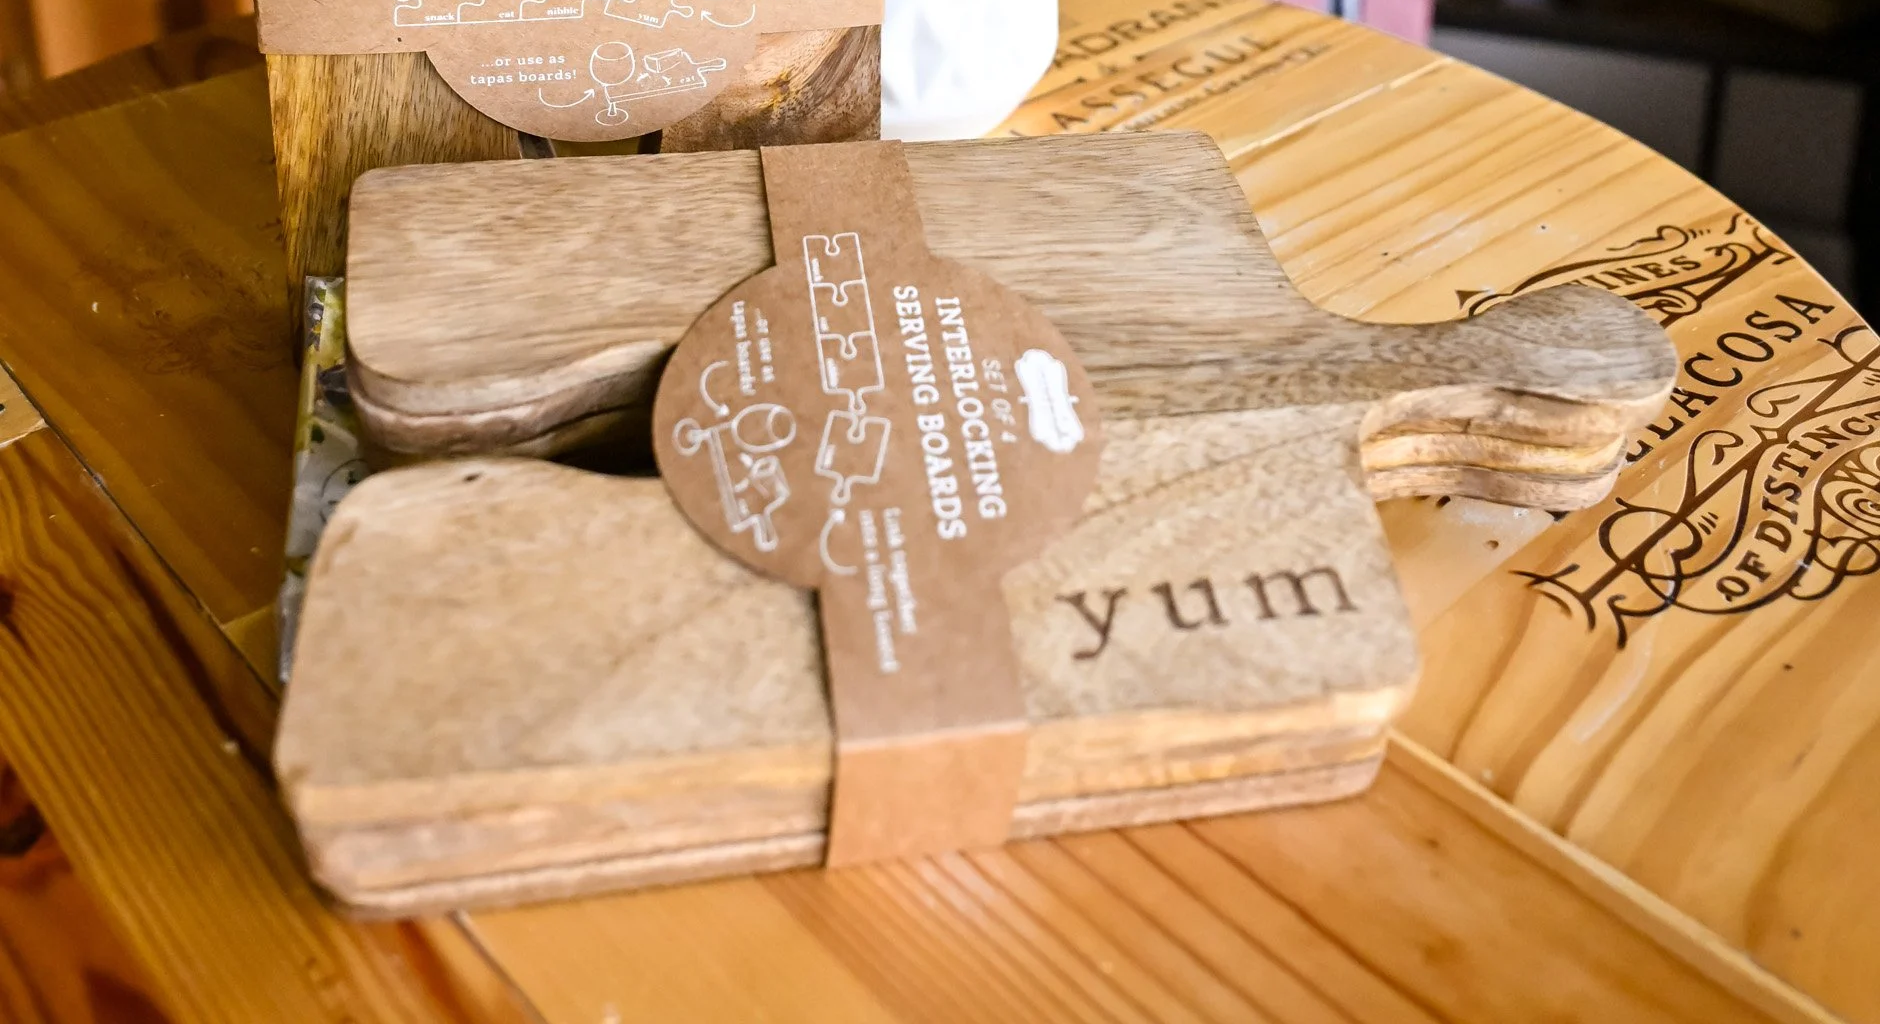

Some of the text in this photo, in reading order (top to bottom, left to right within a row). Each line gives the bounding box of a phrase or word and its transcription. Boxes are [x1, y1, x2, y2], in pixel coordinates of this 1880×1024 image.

[424, 12, 456, 22] snack
[470, 69, 577, 86] tapas boards!
[517, 56, 543, 66] use
[549, 55, 566, 65] as
[1566, 255, 1702, 291] INES
[982, 358, 1008, 393] SET
[893, 285, 968, 540] SERVING BOARDS
[935, 296, 1008, 519] INTERLOCKING
[991, 398, 1017, 426] OF
[1715, 549, 1773, 602] OF
[1054, 564, 1360, 661] yum
